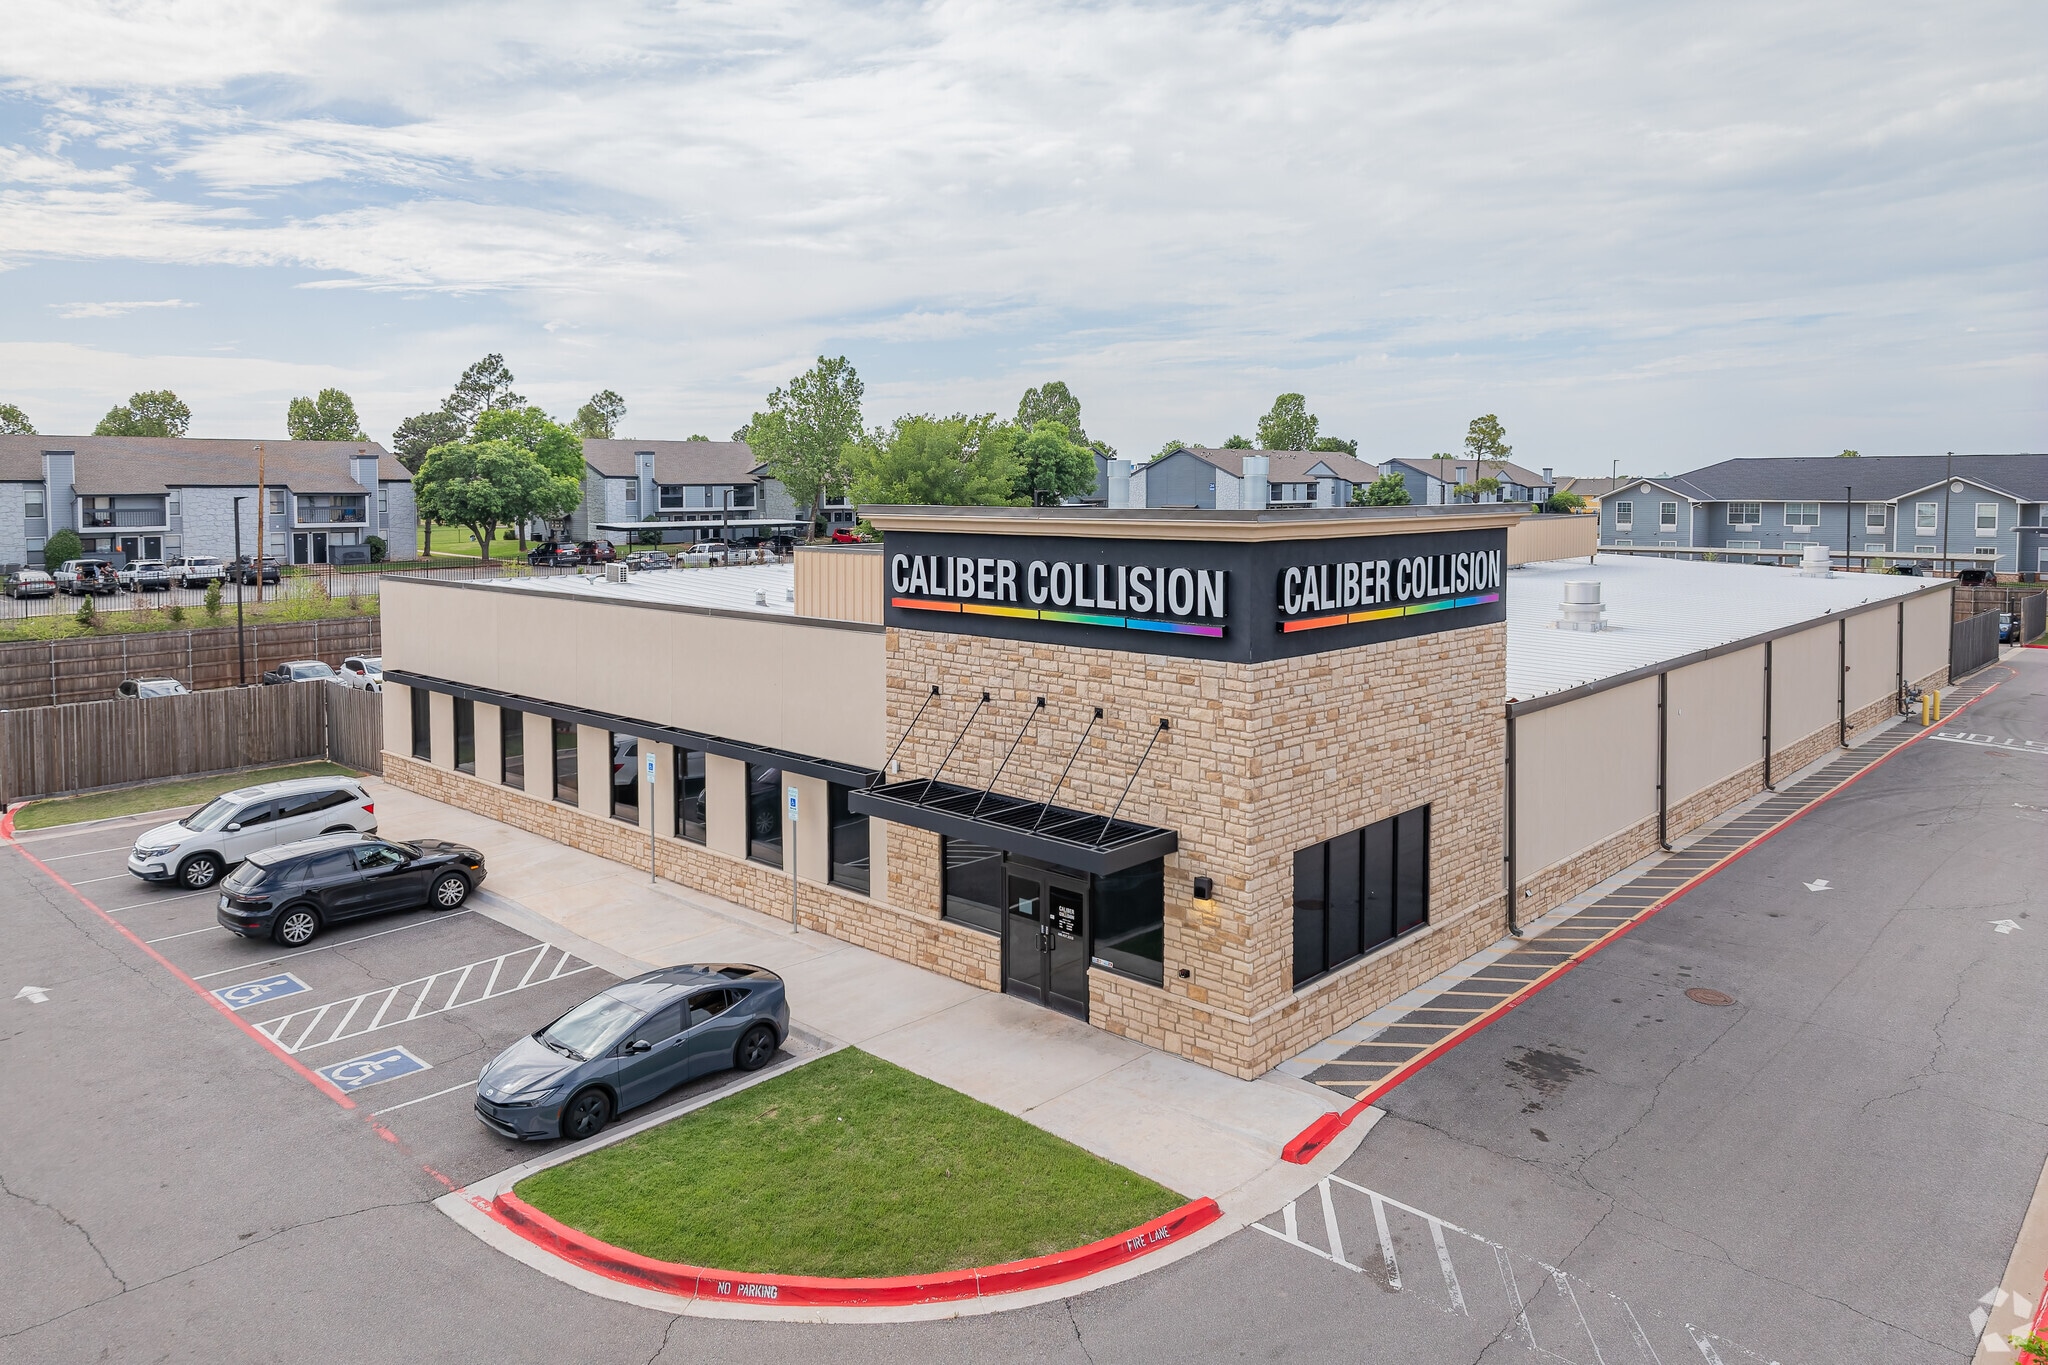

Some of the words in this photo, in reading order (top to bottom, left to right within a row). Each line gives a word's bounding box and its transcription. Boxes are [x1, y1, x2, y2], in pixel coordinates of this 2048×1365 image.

[891, 553, 1018, 602] CALIBER
[1027, 560, 1225, 618] COLLISION
[1283, 560, 1391, 615] CALIBER
[1396, 550, 1501, 601] COLLISION
[1126, 1234, 1147, 1252] FIRE
[1148, 1225, 1171, 1243] LANE
[717, 1281, 731, 1295] NO
[737, 1283, 778, 1299] PARKING
